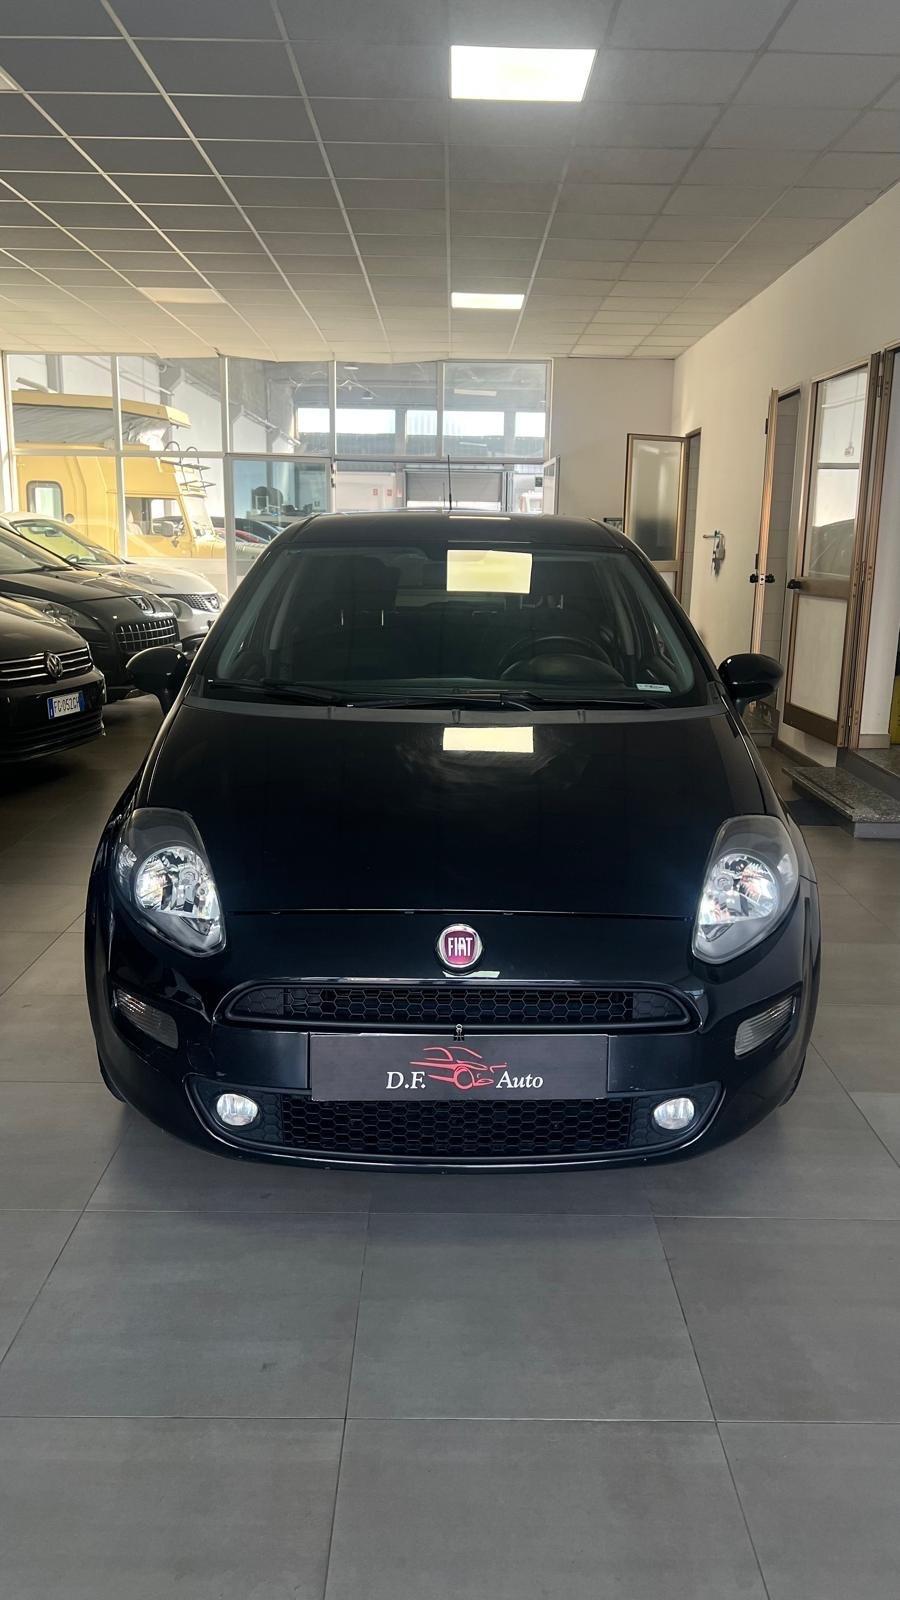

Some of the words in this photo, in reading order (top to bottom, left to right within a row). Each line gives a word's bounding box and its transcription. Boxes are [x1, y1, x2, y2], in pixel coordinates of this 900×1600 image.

[447, 937, 473, 957] FIAT
[385, 1071, 426, 1089] D.F.
[495, 1070, 544, 1089] Auto
